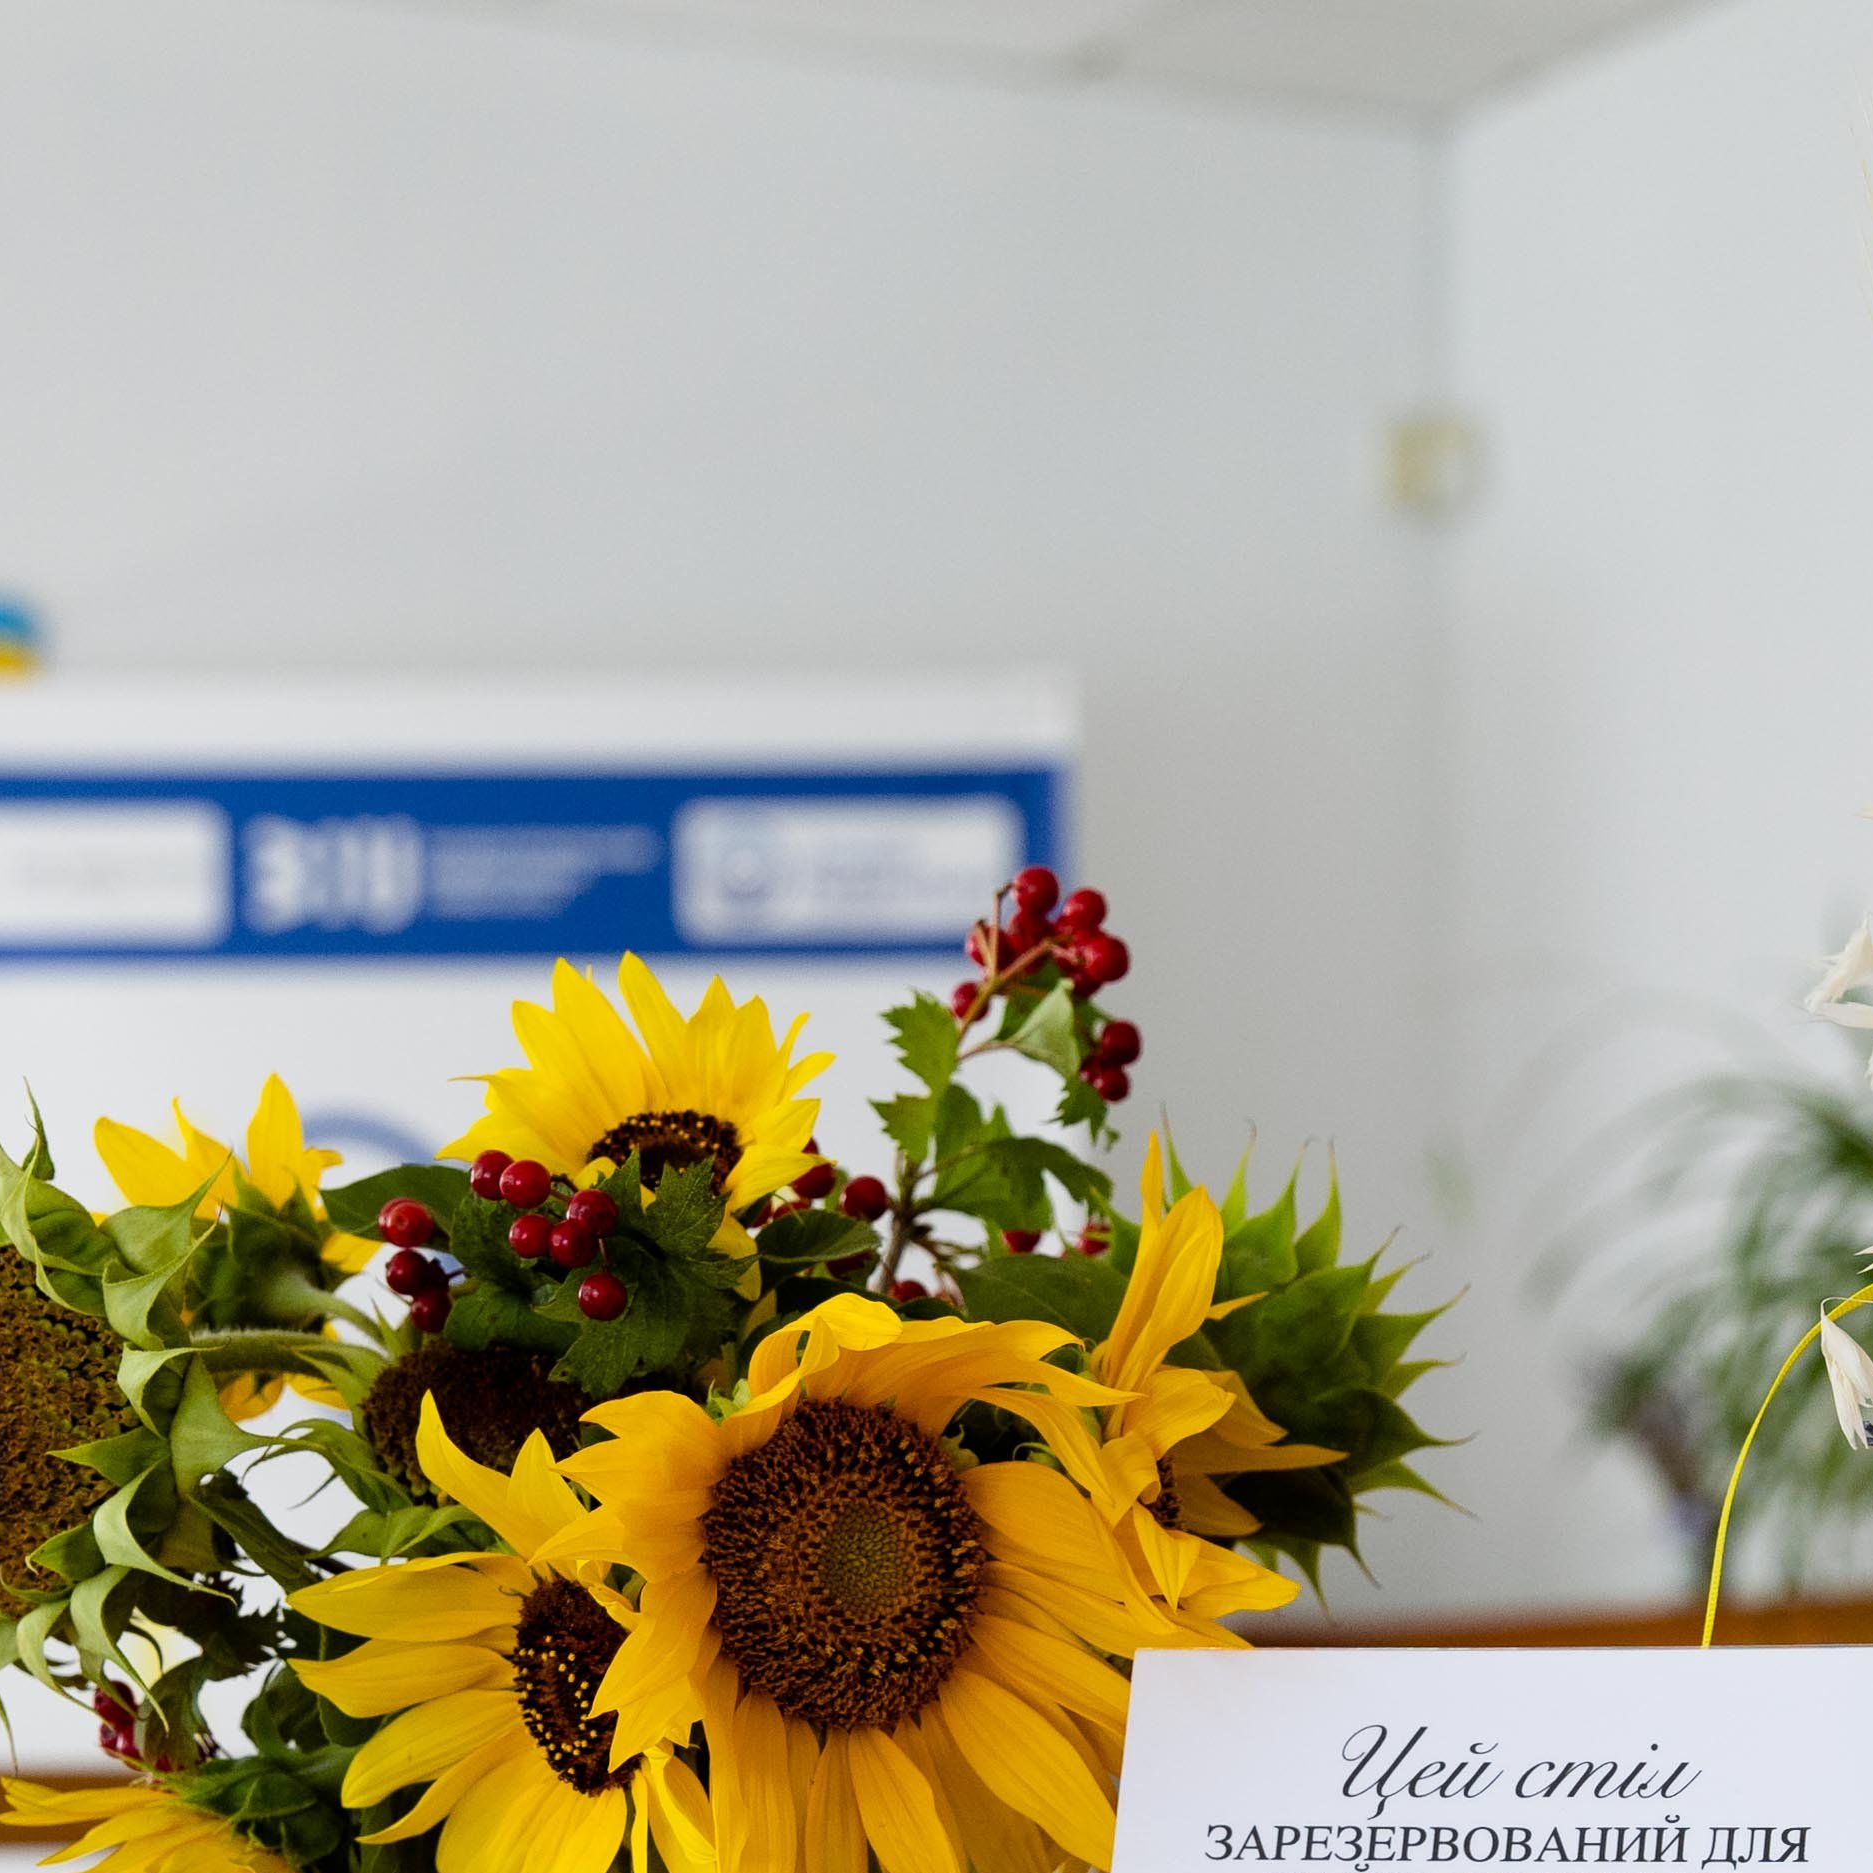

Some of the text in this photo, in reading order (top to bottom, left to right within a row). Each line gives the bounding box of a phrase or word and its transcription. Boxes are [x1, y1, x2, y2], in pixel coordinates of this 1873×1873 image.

[1341, 1724, 1703, 1821] Цей стіл
[1204, 1814, 1812, 1871] ЗАРЕЗЕРВОВАНИЙ ДЛЯ
